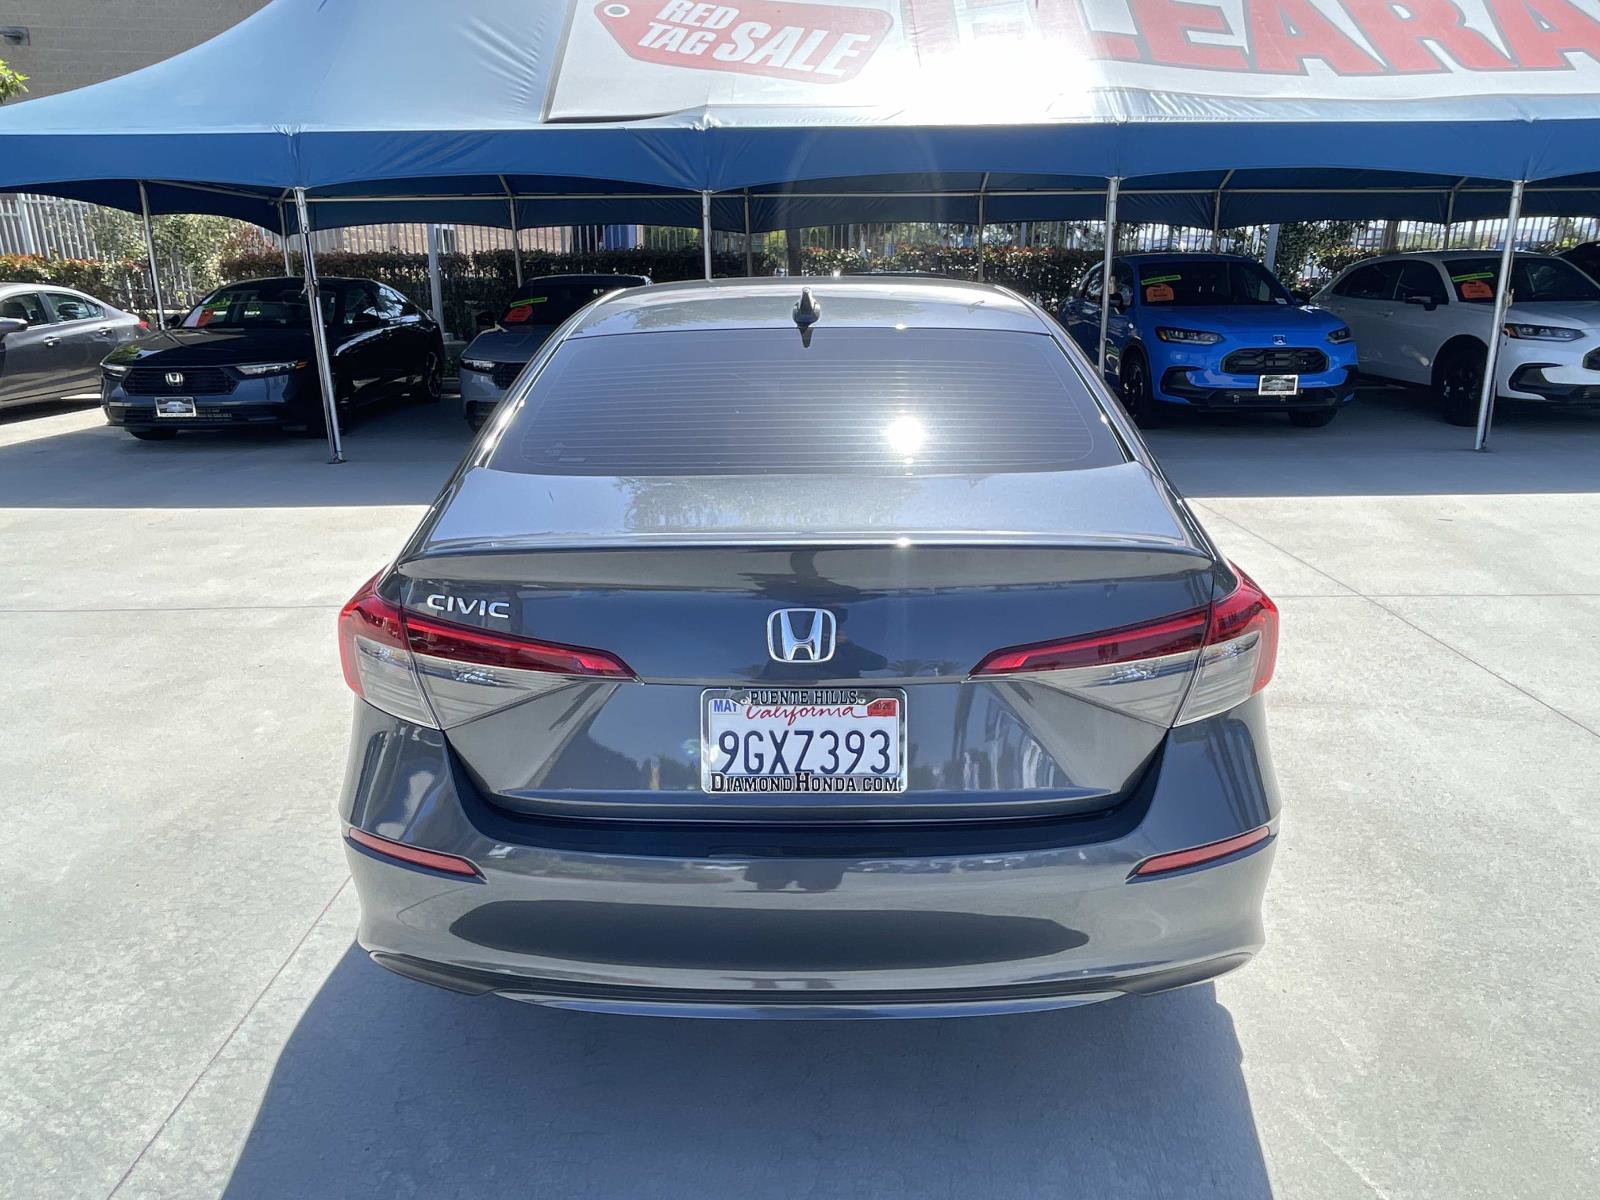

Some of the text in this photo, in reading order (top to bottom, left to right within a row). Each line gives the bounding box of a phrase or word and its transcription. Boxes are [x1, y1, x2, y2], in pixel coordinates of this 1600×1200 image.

[655, 0, 740, 30] RED
[637, 21, 872, 79] TAG SALE
[426, 593, 510, 619] CIVIC
[751, 690, 809, 705] PUENTE
[814, 690, 859, 705] HILLS
[713, 700, 738, 713] MAY
[745, 704, 868, 727] California
[718, 729, 891, 775] 9GXZ393
